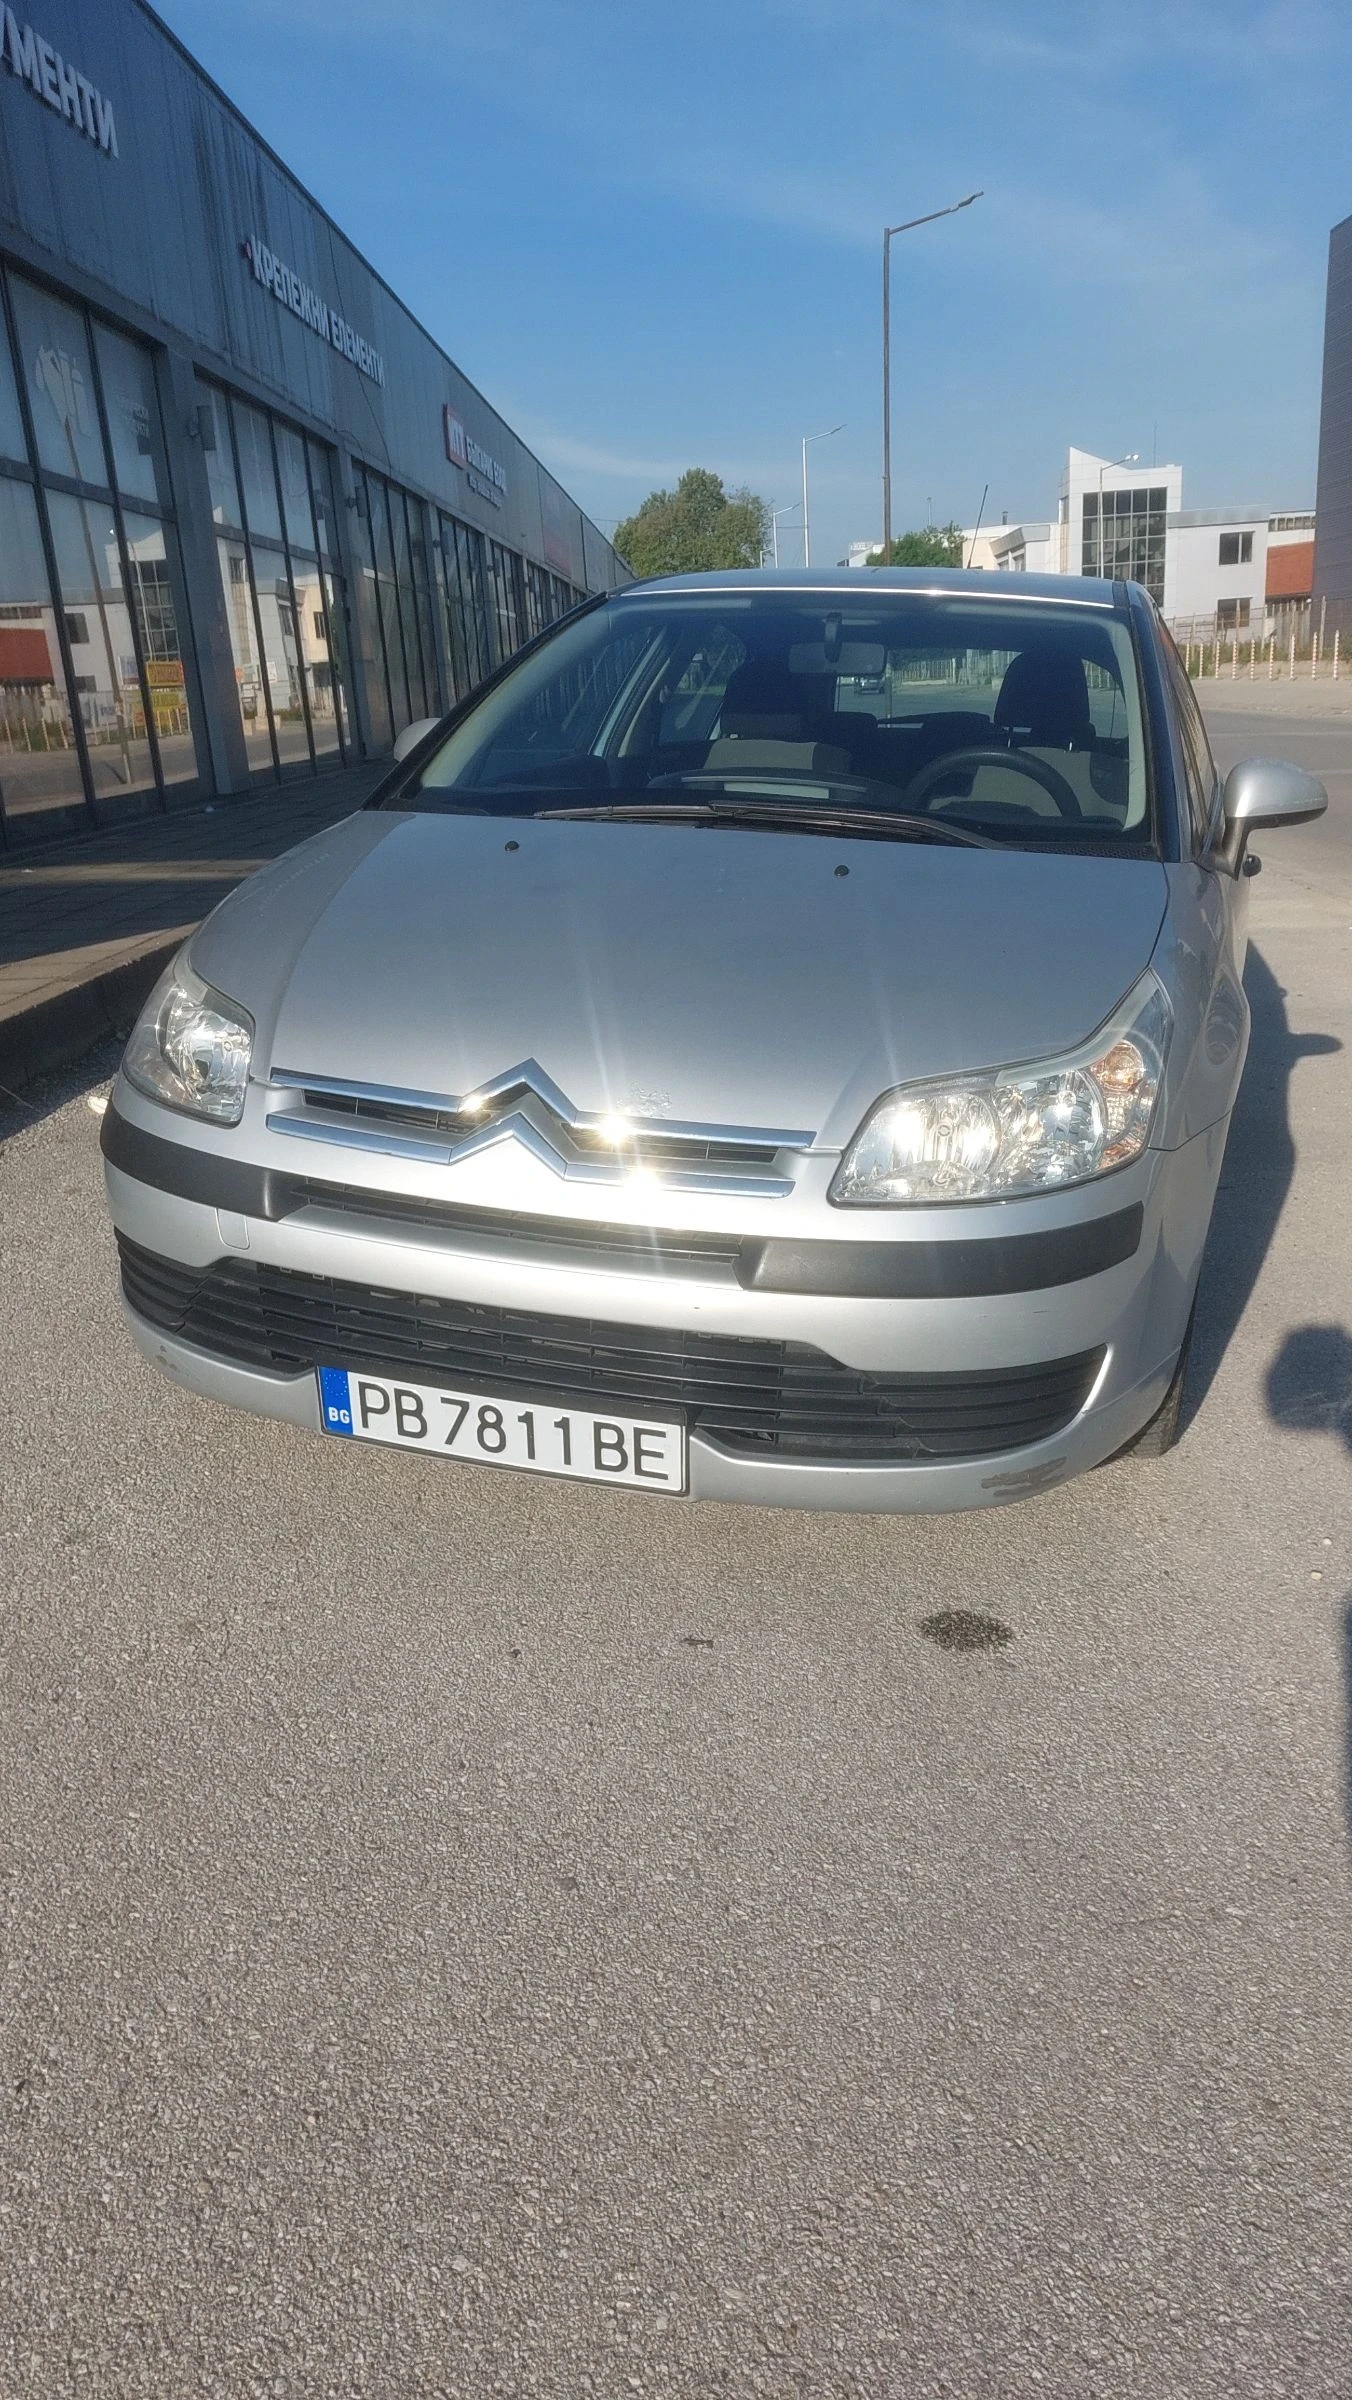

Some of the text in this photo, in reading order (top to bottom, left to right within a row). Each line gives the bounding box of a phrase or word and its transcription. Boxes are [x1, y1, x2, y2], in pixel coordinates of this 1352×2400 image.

[251, 234, 386, 389] КРЕПЕЖНИ ЕЛЕМЕНТИ
[328, 1406, 351, 1425] BG
[357, 1380, 669, 1481] PB 7811 BE
